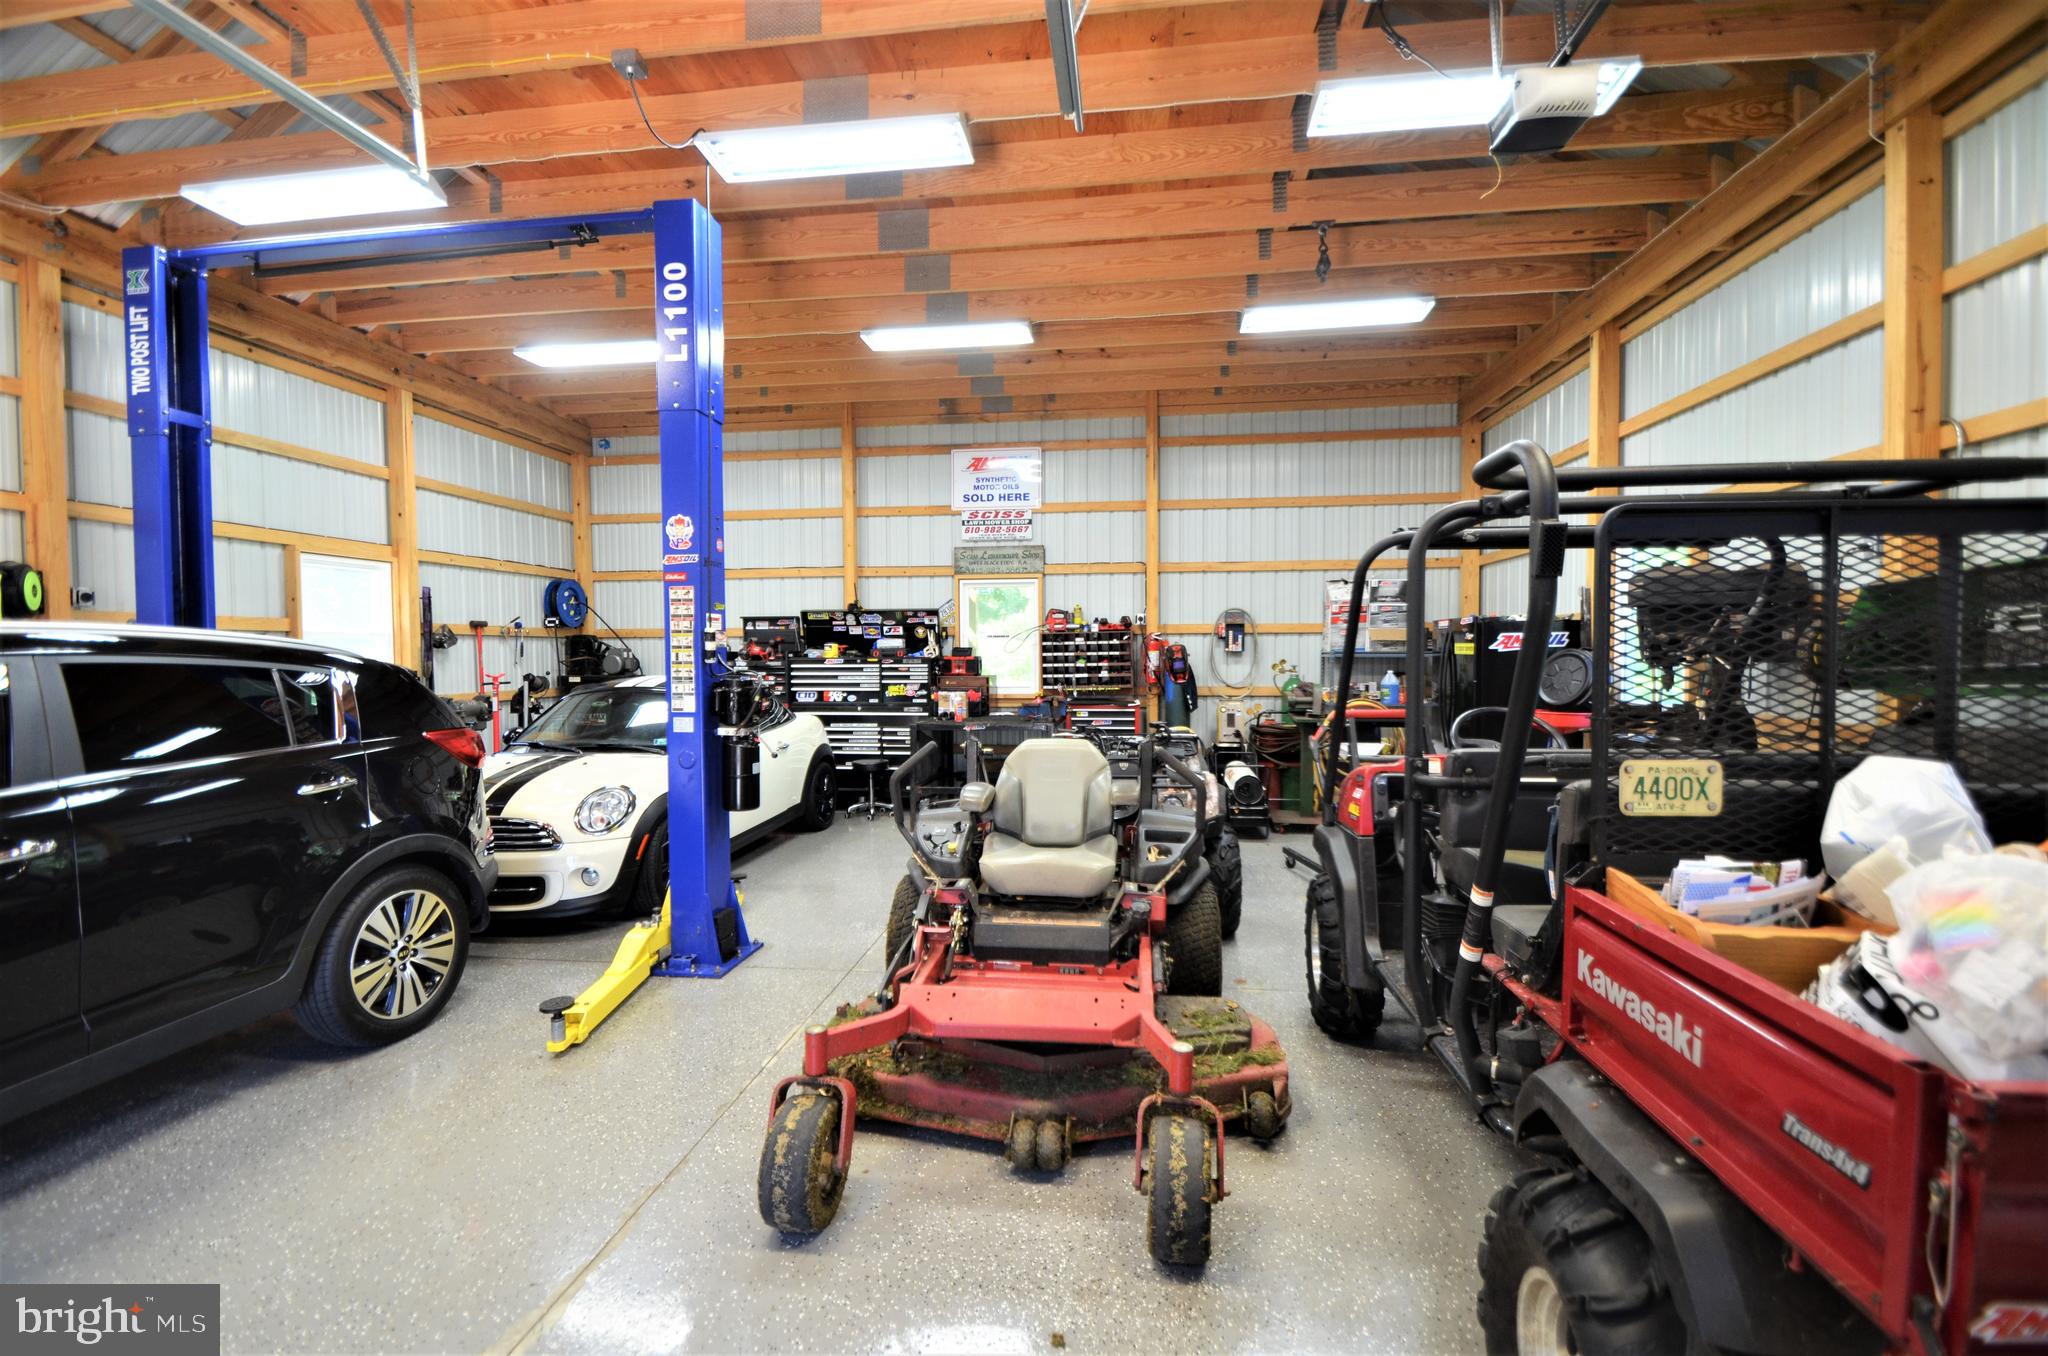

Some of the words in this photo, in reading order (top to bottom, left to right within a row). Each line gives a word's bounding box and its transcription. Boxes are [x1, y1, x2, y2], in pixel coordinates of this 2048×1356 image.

[129, 306, 149, 332] LIFT
[663, 262, 689, 362] L1100
[130, 334, 150, 366] POST
[131, 367, 151, 396] TWO
[963, 494, 995, 503] SOLD
[998, 493, 1031, 502] HERE
[964, 526, 1030, 534] 610-982-5667
[1021, 550, 1040, 560] Shop
[1633, 776, 1710, 801] 4400X
[1577, 948, 1703, 1068] Kawasaki
